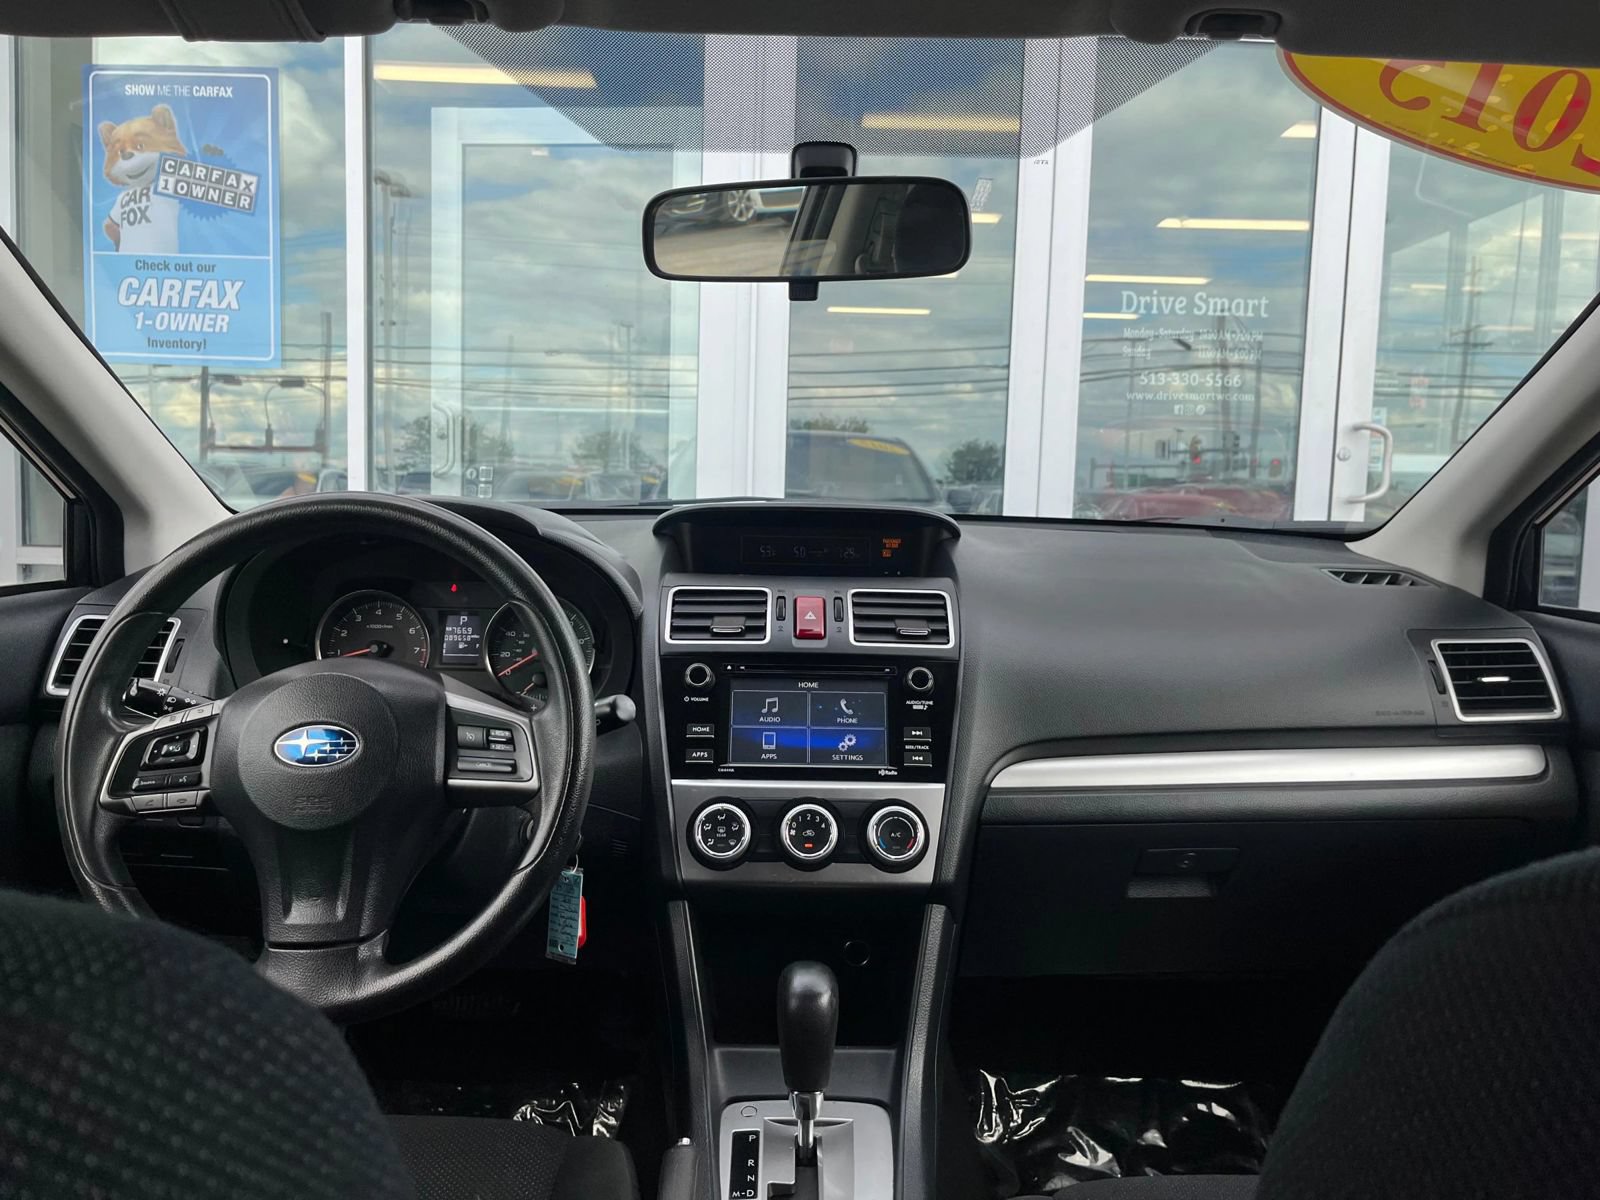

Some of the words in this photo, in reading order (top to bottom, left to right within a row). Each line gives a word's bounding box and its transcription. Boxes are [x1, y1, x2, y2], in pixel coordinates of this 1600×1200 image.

[125, 84, 155, 96] SHOW
[157, 85, 172, 97] ME
[173, 85, 191, 97] THE
[193, 85, 233, 98] CARFAX
[163, 159, 256, 194] CARFAX
[120, 187, 150, 209] CAR
[120, 208, 152, 229] FOX
[135, 259, 170, 272] Check
[174, 261, 193, 273] out
[197, 264, 217, 273] our
[118, 276, 245, 310] CARFAX
[1120, 290, 1187, 315] Drive
[1193, 292, 1270, 318] Smart
[135, 312, 229, 333] 1-OWNER
[147, 337, 207, 350] Inventory!
[1139, 372, 1242, 387] 513-330-5566
[460, 615, 468, 625] P
[408, 627, 416, 635] 6
[798, 681, 819, 689] HOME
[759, 715, 781, 723] AUDIO
[832, 753, 864, 762] SETTINGS
[815, 815, 820, 823] 3
[748, 1134, 757, 1142] P
[747, 1159, 755, 1167] R
[747, 1174, 755, 1182] N
